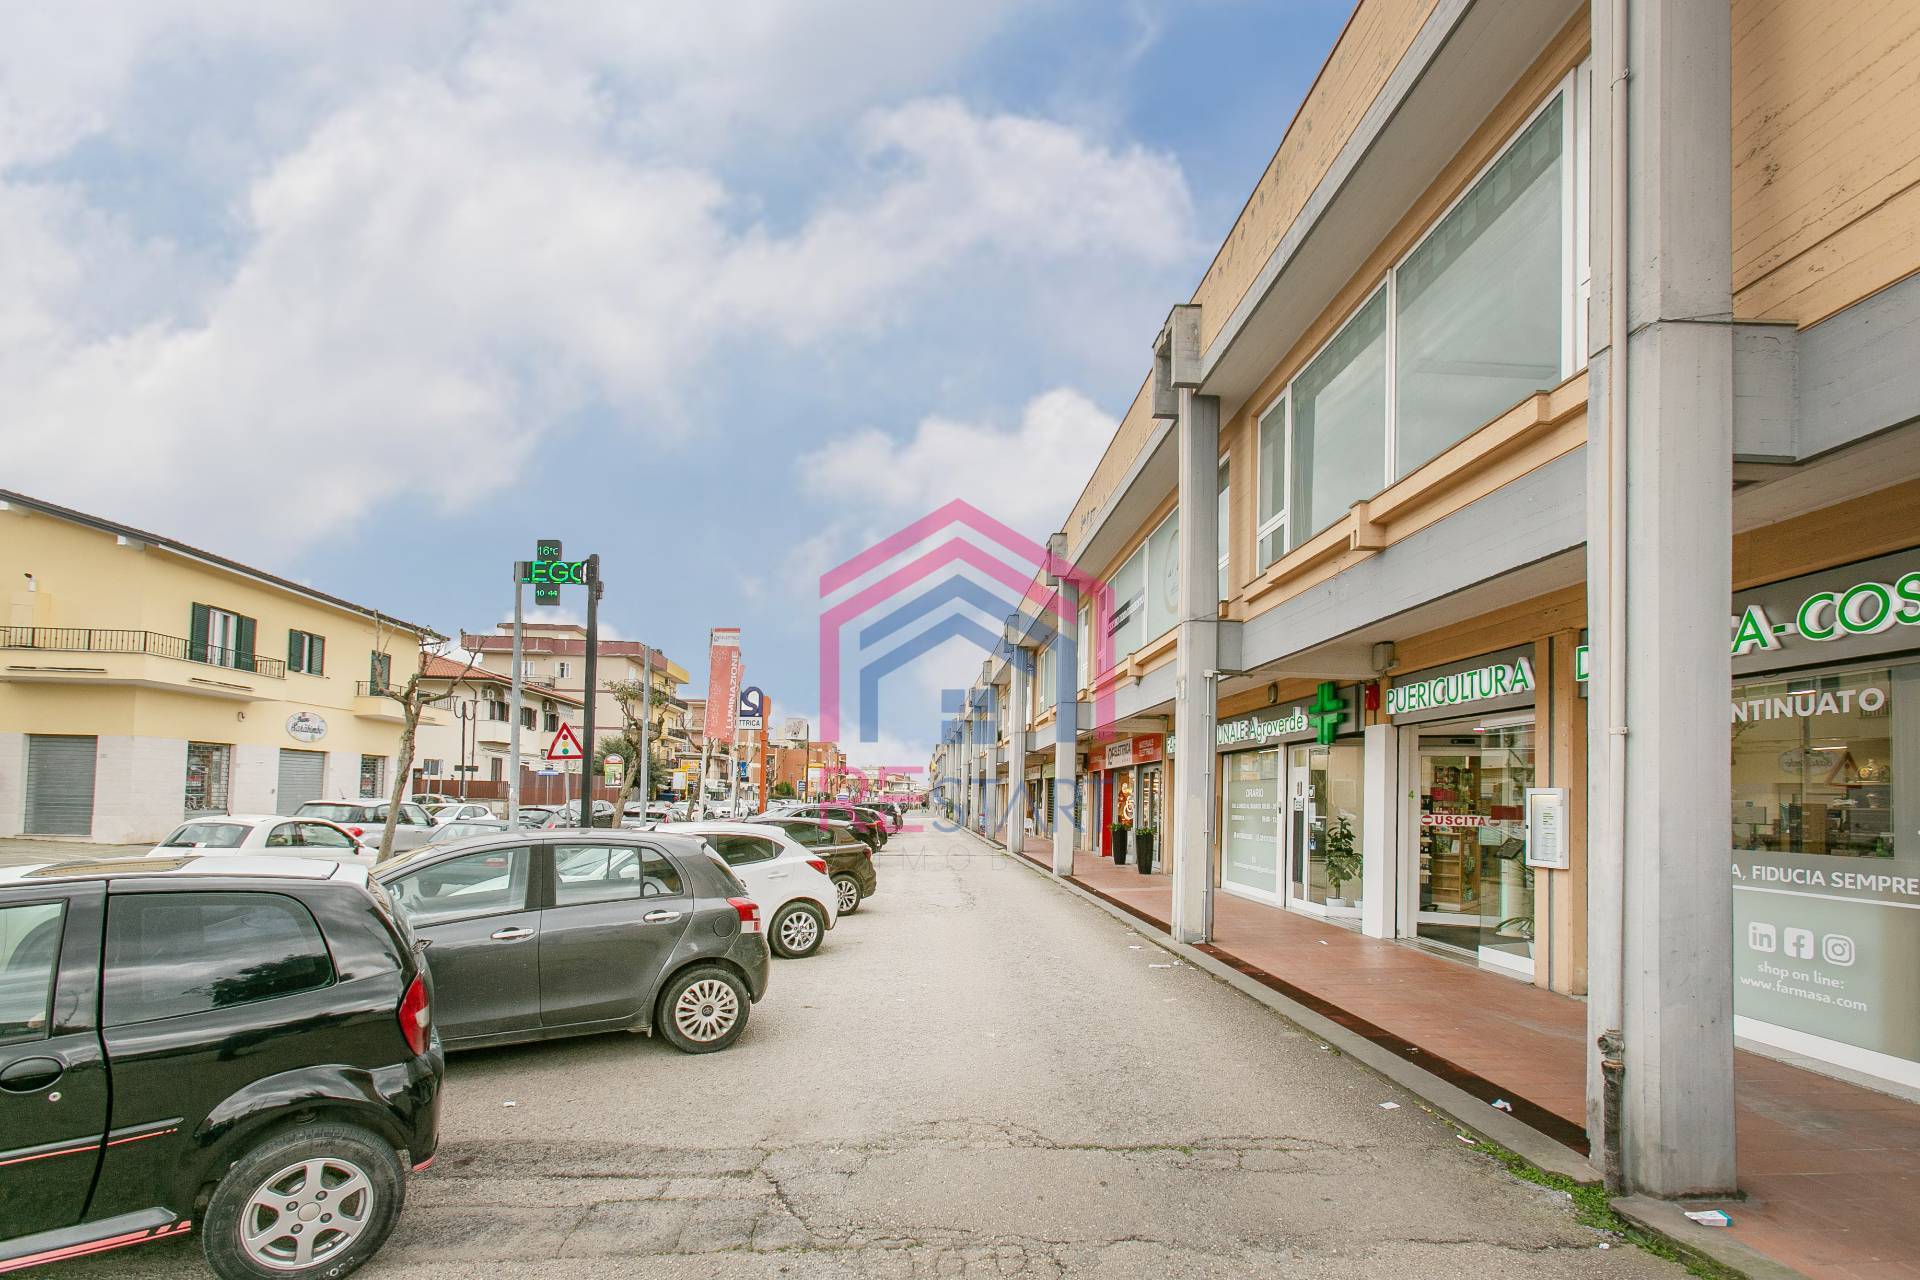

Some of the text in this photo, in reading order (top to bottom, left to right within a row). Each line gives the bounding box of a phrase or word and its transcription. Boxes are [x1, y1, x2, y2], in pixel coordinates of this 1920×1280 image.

[1386, 657, 1532, 714] PUERICULTURA
[1250, 707, 1305, 743] Agroverde
[1434, 815, 1486, 827] USCITA
[1752, 865, 1826, 887] FIDUCIA
[1830, 871, 1920, 896] SEMPRE
[1757, 961, 1845, 989] shop on line:
[1740, 975, 1868, 1012] www.farmasa.com
